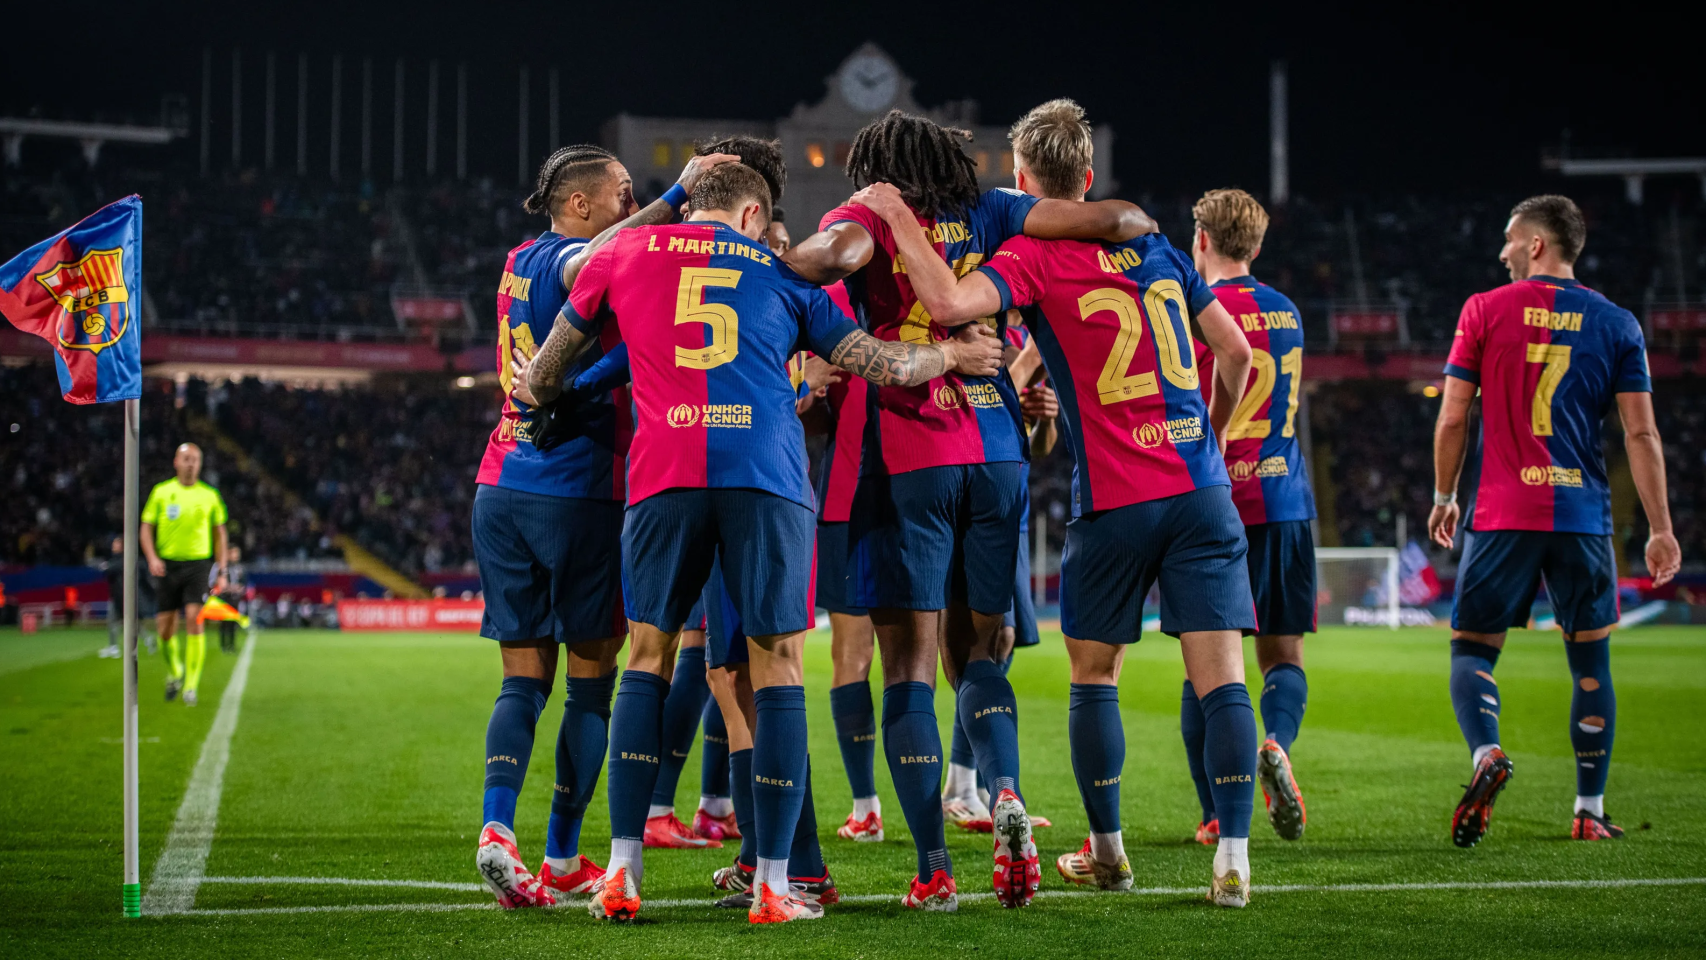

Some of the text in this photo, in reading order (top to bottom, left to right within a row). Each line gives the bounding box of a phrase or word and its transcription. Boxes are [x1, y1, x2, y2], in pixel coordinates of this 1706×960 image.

[922, 220, 973, 246] OUNDE
[667, 236, 772, 267] MARTINEZ
[1097, 247, 1142, 274] OLMO
[72, 291, 109, 311] FCB
[674, 266, 743, 370] 5
[1239, 312, 1262, 332] DE
[1259, 310, 1299, 331] JONG
[1523, 306, 1583, 332] FERRAN
[1077, 279, 1200, 406] 20
[1226, 346, 1303, 441] 21
[1525, 342, 1572, 436] 7
[702, 404, 752, 414] UNHCR
[701, 413, 752, 424] ACNUR
[1162, 417, 1201, 431] UNHCR
[1167, 427, 1204, 440] ACNUR
[974, 705, 1013, 720] BARÇA
[487, 754, 518, 766] BARÇA
[621, 751, 659, 765] BARÇA
[900, 755, 939, 765] BARÇA
[755, 775, 794, 787] BARÇA
[1094, 774, 1122, 787] BARÇA
[1215, 774, 1252, 786] BARÇA
